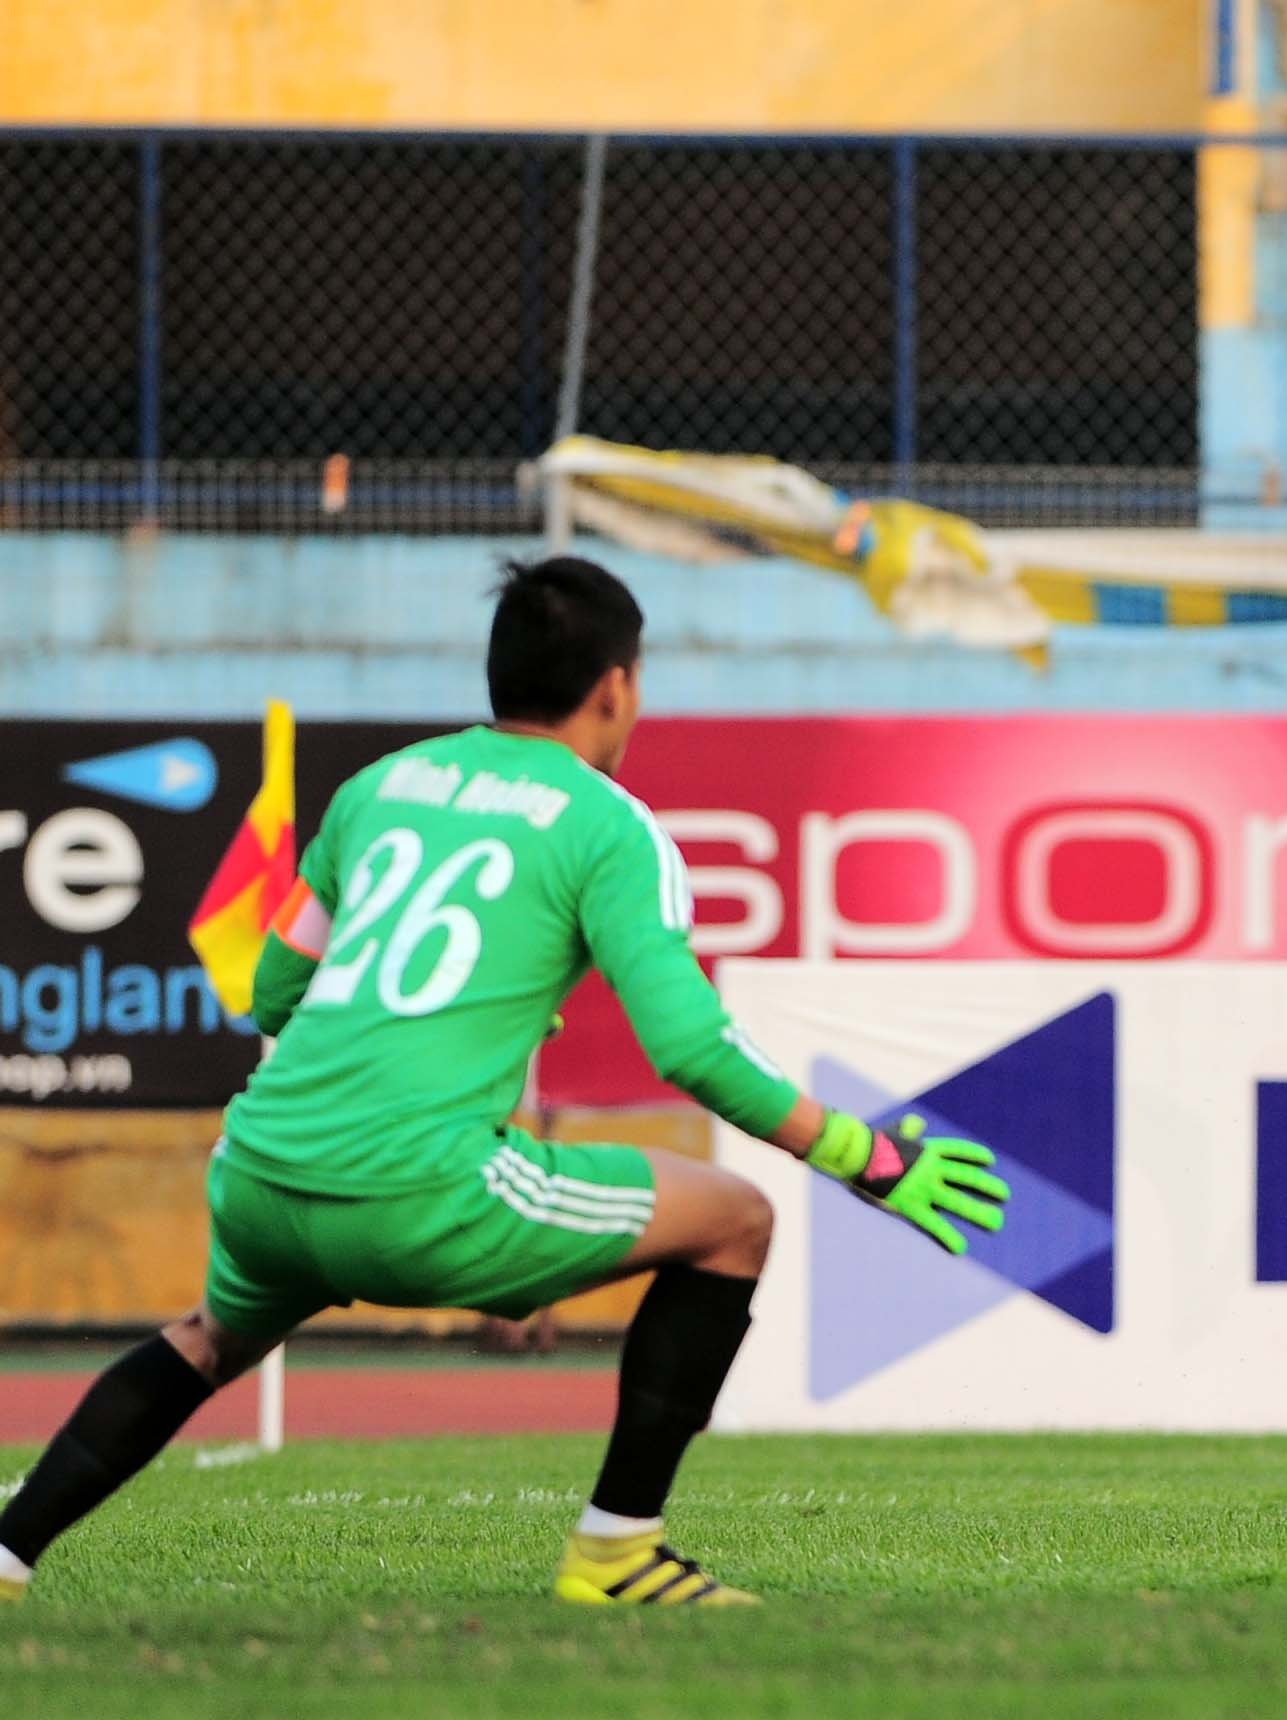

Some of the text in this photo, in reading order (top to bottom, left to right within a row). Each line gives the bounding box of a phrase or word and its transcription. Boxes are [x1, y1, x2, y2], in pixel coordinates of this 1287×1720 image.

[0, 805, 144, 933] e
[300, 827, 515, 1016] 26
[0, 945, 259, 1053] glan
